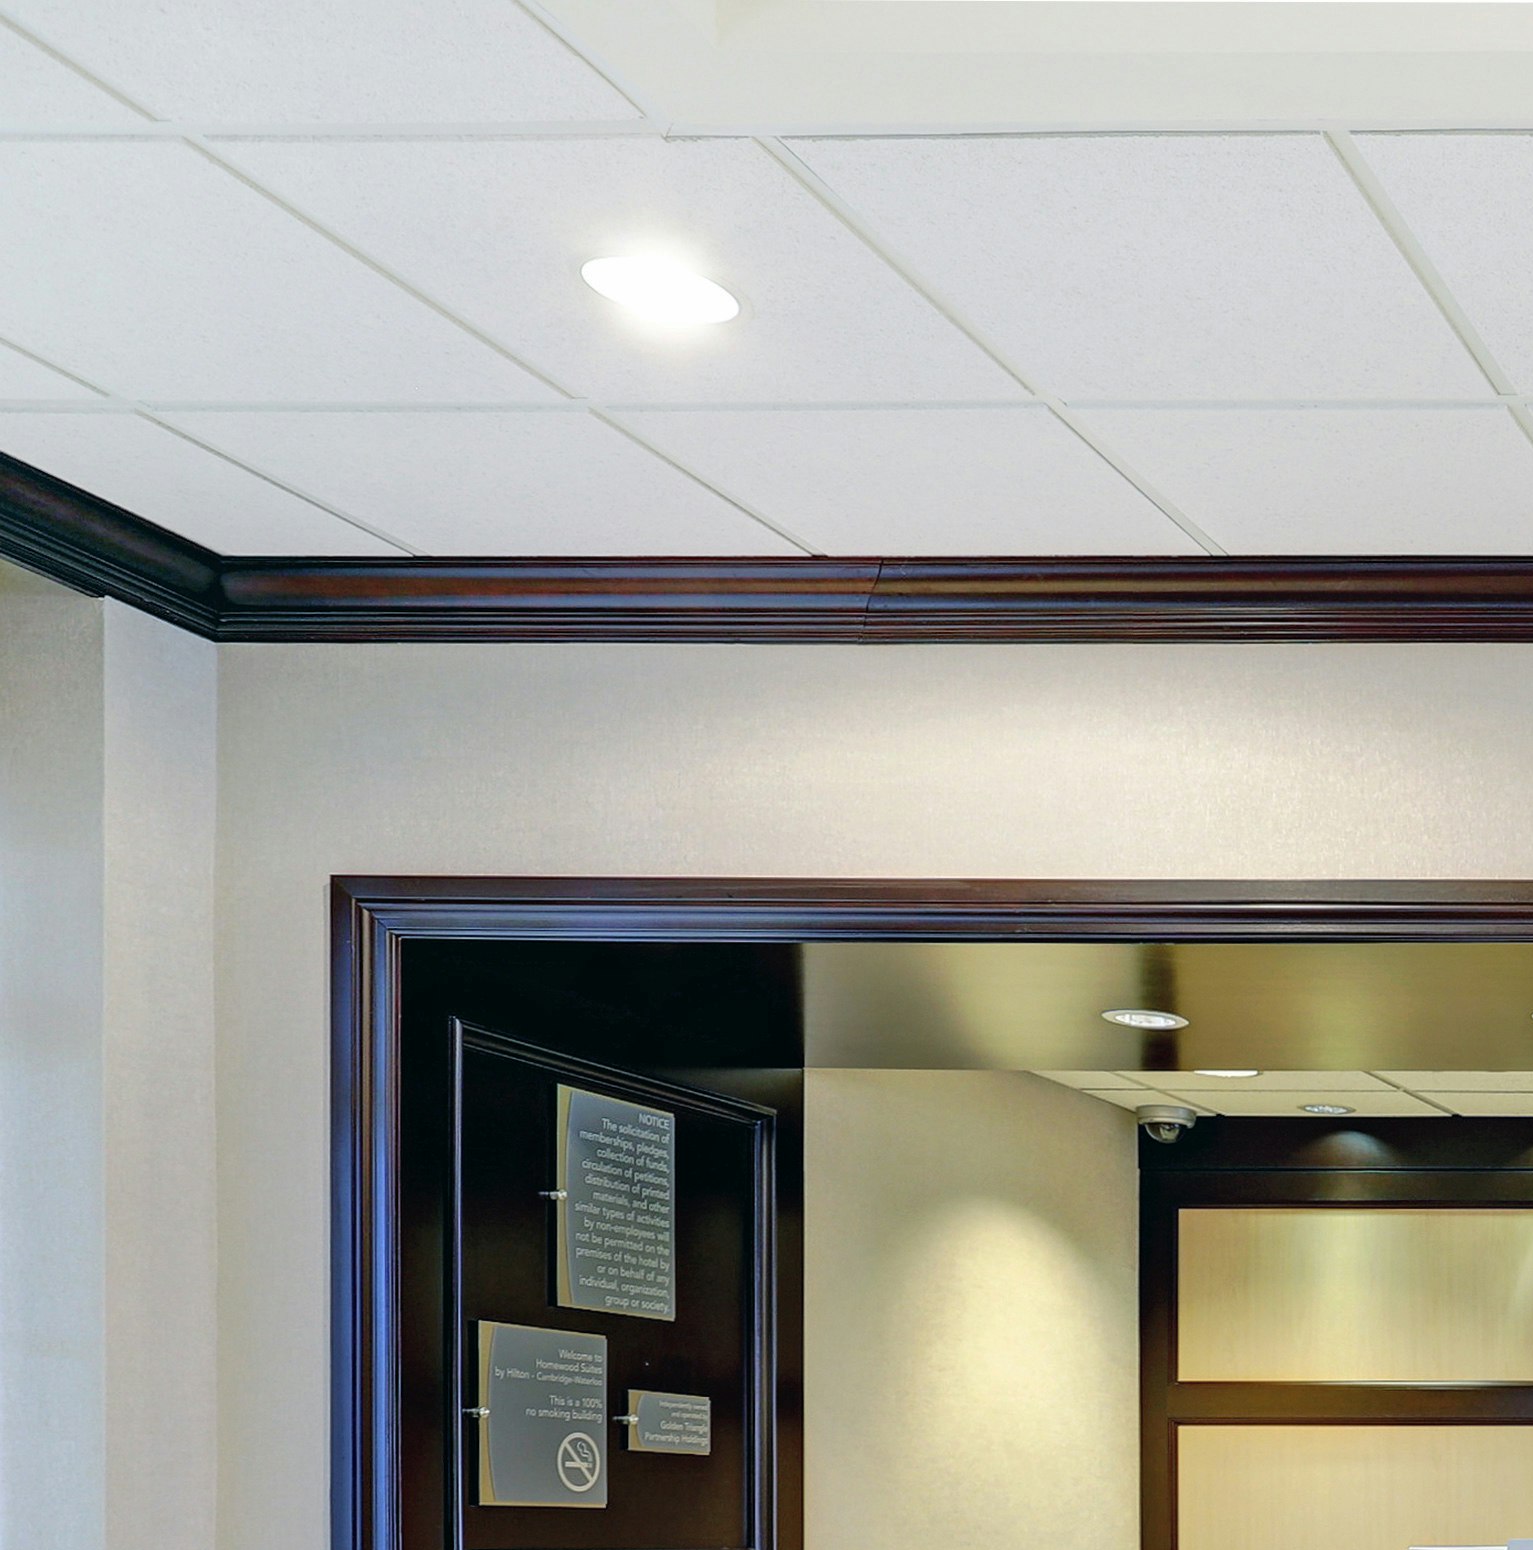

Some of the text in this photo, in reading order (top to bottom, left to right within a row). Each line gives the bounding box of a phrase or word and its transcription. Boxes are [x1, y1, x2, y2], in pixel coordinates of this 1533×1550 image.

[639, 1113, 670, 1130] NOTICE
[602, 1118, 670, 1144] The solicitation of
[597, 1148, 634, 1164] collection
[636, 1156, 645, 1166] of
[582, 1159, 622, 1176] circulation
[624, 1168, 633, 1178] of
[584, 1173, 670, 1200] distribution of printed
[574, 1202, 670, 1228] similar types of activities
[632, 1200, 648, 1210] and
[649, 1202, 670, 1214] other
[584, 1216, 670, 1242] by non-employees will
[576, 1232, 670, 1256] not be permitted on the
[576, 1247, 670, 1272] premises of the hotel by
[579, 1275, 619, 1292] individual,
[596, 1265, 670, 1287] or on behalf of any
[604, 1295, 629, 1309] group
[559, 1349, 602, 1362] Welcome to
[494, 1366, 505, 1379] by
[506, 1368, 530, 1379] Hilton
[536, 1358, 602, 1374] Homewood Suites
[549, 1394, 565, 1406] This
[567, 1398, 573, 1407] is
[582, 1397, 602, 1409] 100%
[526, 1408, 602, 1424] no smoking building
